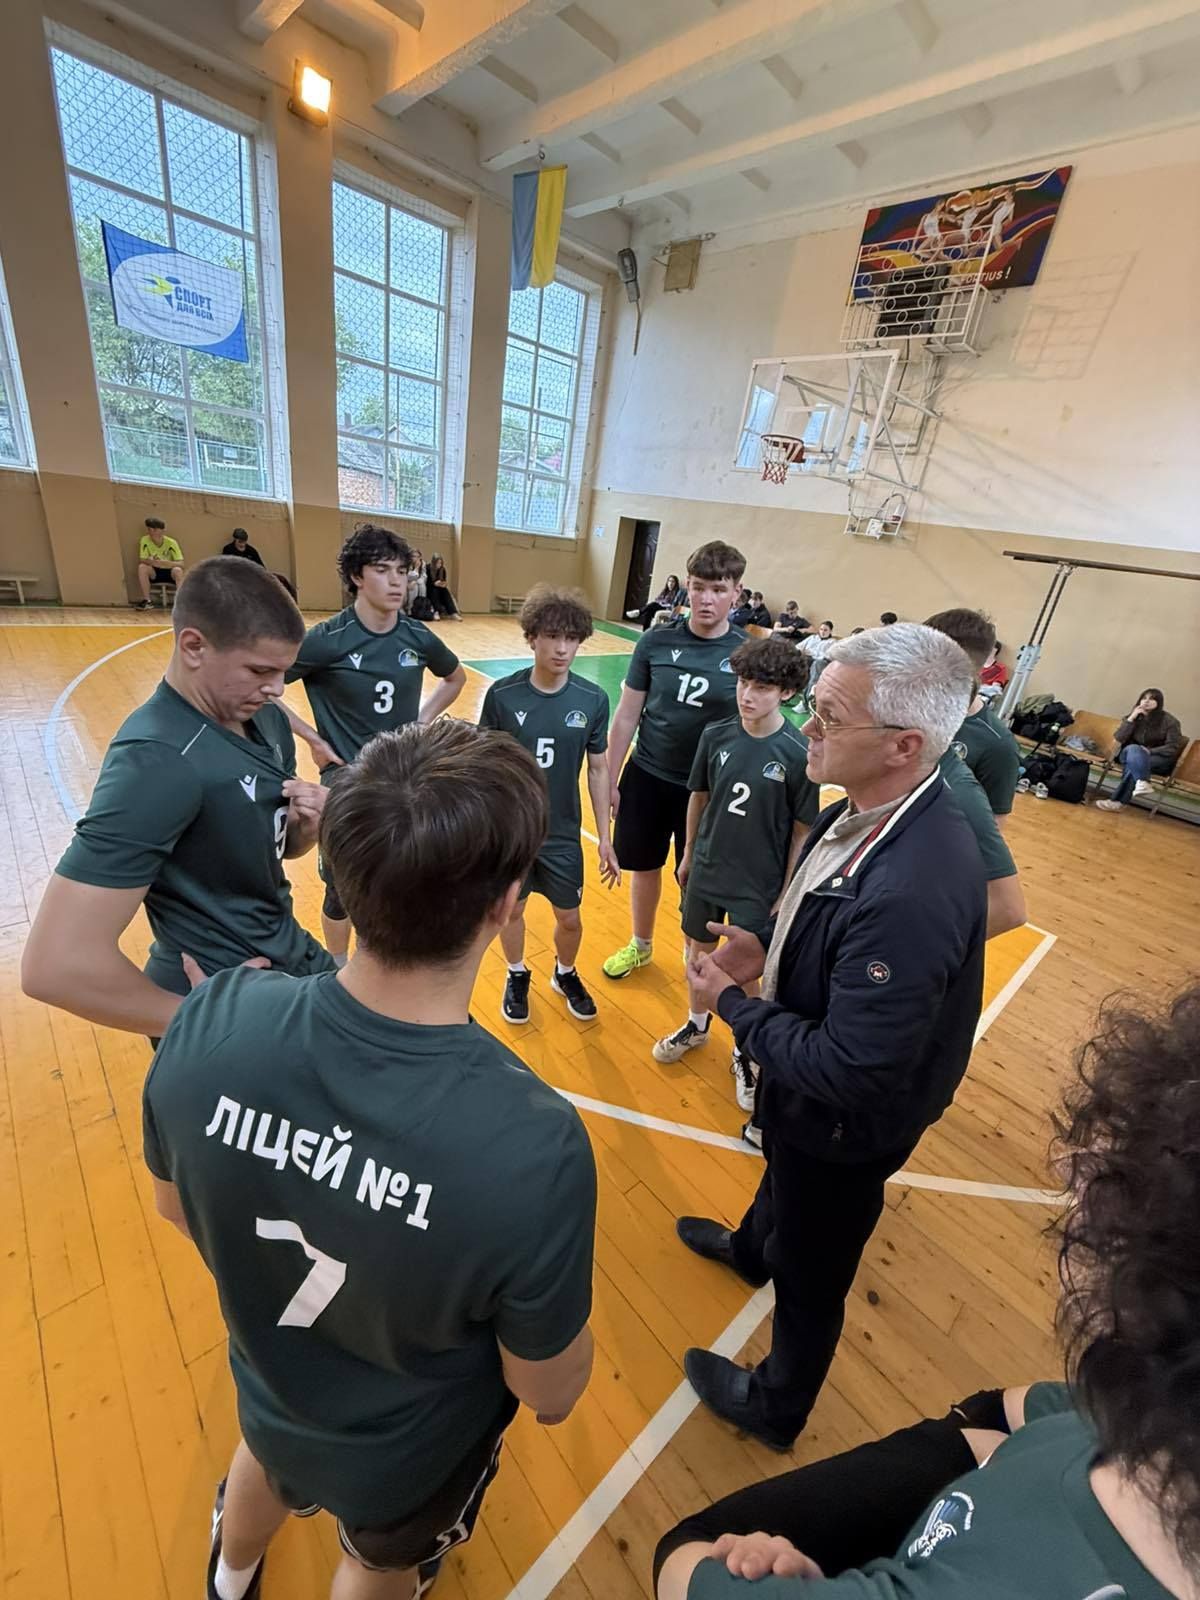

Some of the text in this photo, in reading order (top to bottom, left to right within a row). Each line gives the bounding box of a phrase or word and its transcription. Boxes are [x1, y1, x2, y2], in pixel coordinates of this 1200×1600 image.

[175, 286, 212, 311] СПОРТ
[373, 680, 395, 714] 3
[677, 673, 709, 707] 12
[536, 737, 555, 769] 5
[727, 782, 750, 817] 2
[274, 805, 289, 860] 9
[355, 1157, 433, 1231] №1
[255, 1217, 348, 1328] 7
